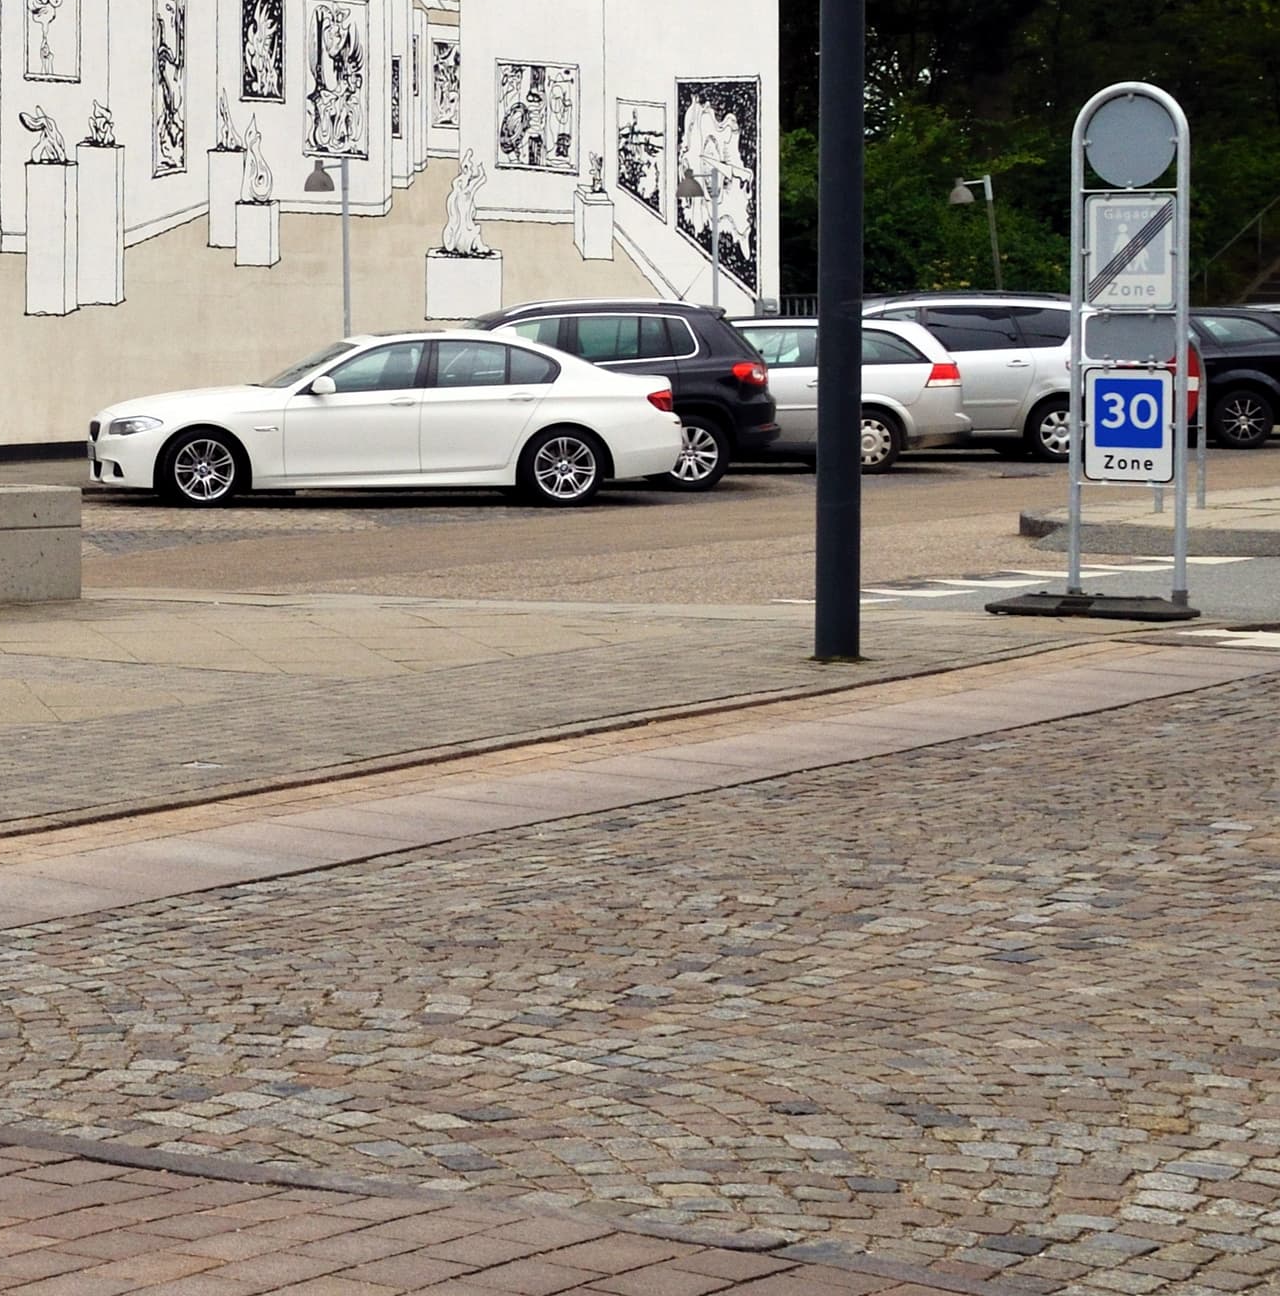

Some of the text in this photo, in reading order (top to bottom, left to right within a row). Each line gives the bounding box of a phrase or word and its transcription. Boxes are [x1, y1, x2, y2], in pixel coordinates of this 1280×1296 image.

[1107, 282, 1156, 297] Zone
[1101, 392, 1159, 430] 30
[1103, 454, 1154, 471] Zone
